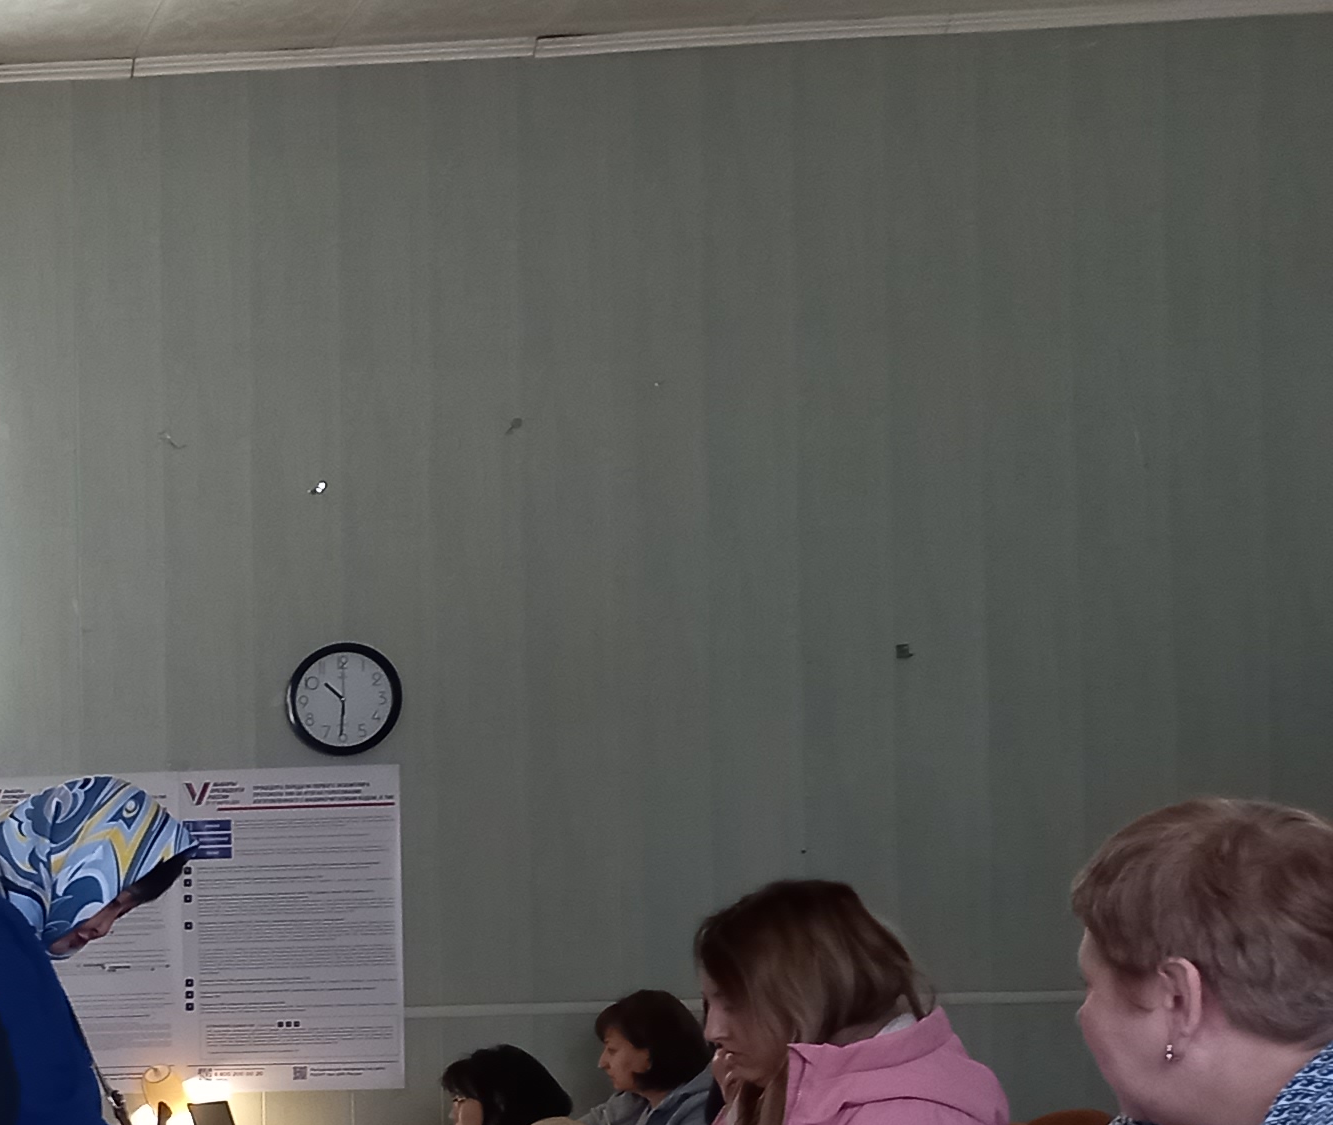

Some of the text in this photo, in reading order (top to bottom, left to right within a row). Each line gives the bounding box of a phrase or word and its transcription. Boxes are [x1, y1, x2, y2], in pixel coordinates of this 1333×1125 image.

[304, 676, 319, 690] 10
[372, 672, 381, 686] 2
[298, 695, 309, 708] 9
[378, 691, 387, 705] 3
[305, 713, 315, 727] 8
[321, 725, 331, 739] 7
[358, 724, 367, 738] 5
